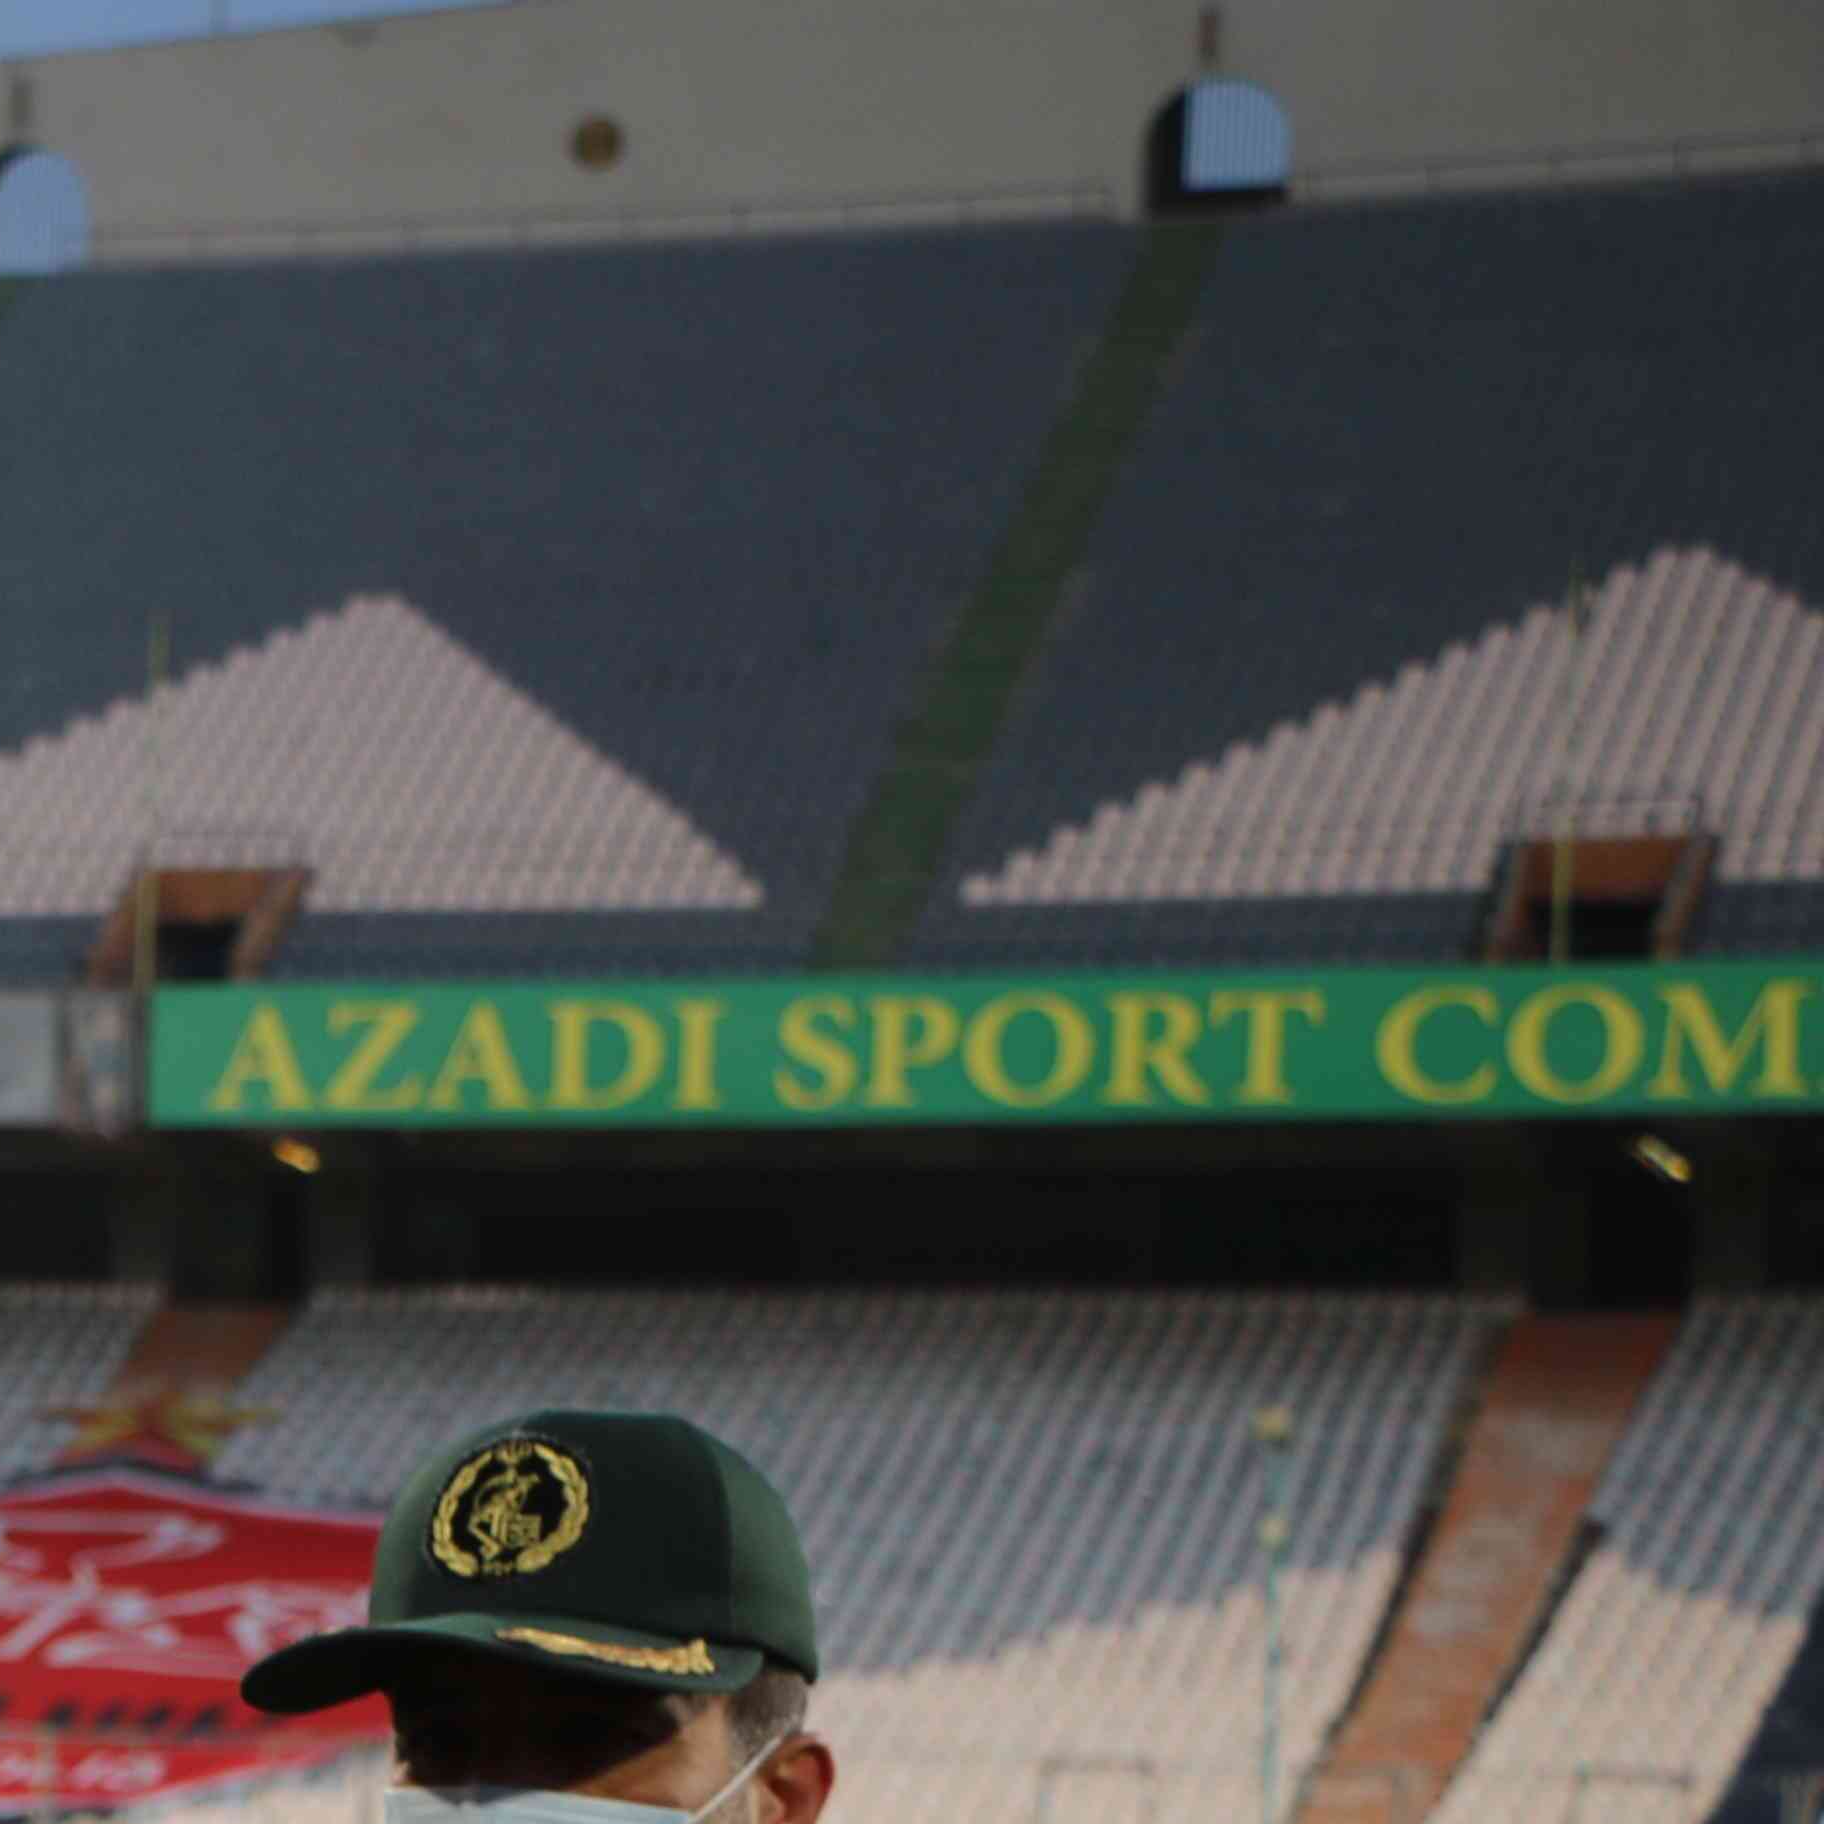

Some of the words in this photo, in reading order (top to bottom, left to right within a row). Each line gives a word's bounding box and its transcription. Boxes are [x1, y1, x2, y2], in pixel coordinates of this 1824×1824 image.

[204, 996, 726, 1112] AZADI
[772, 988, 1326, 1112] SPORT
[1374, 976, 1818, 1106] COM
